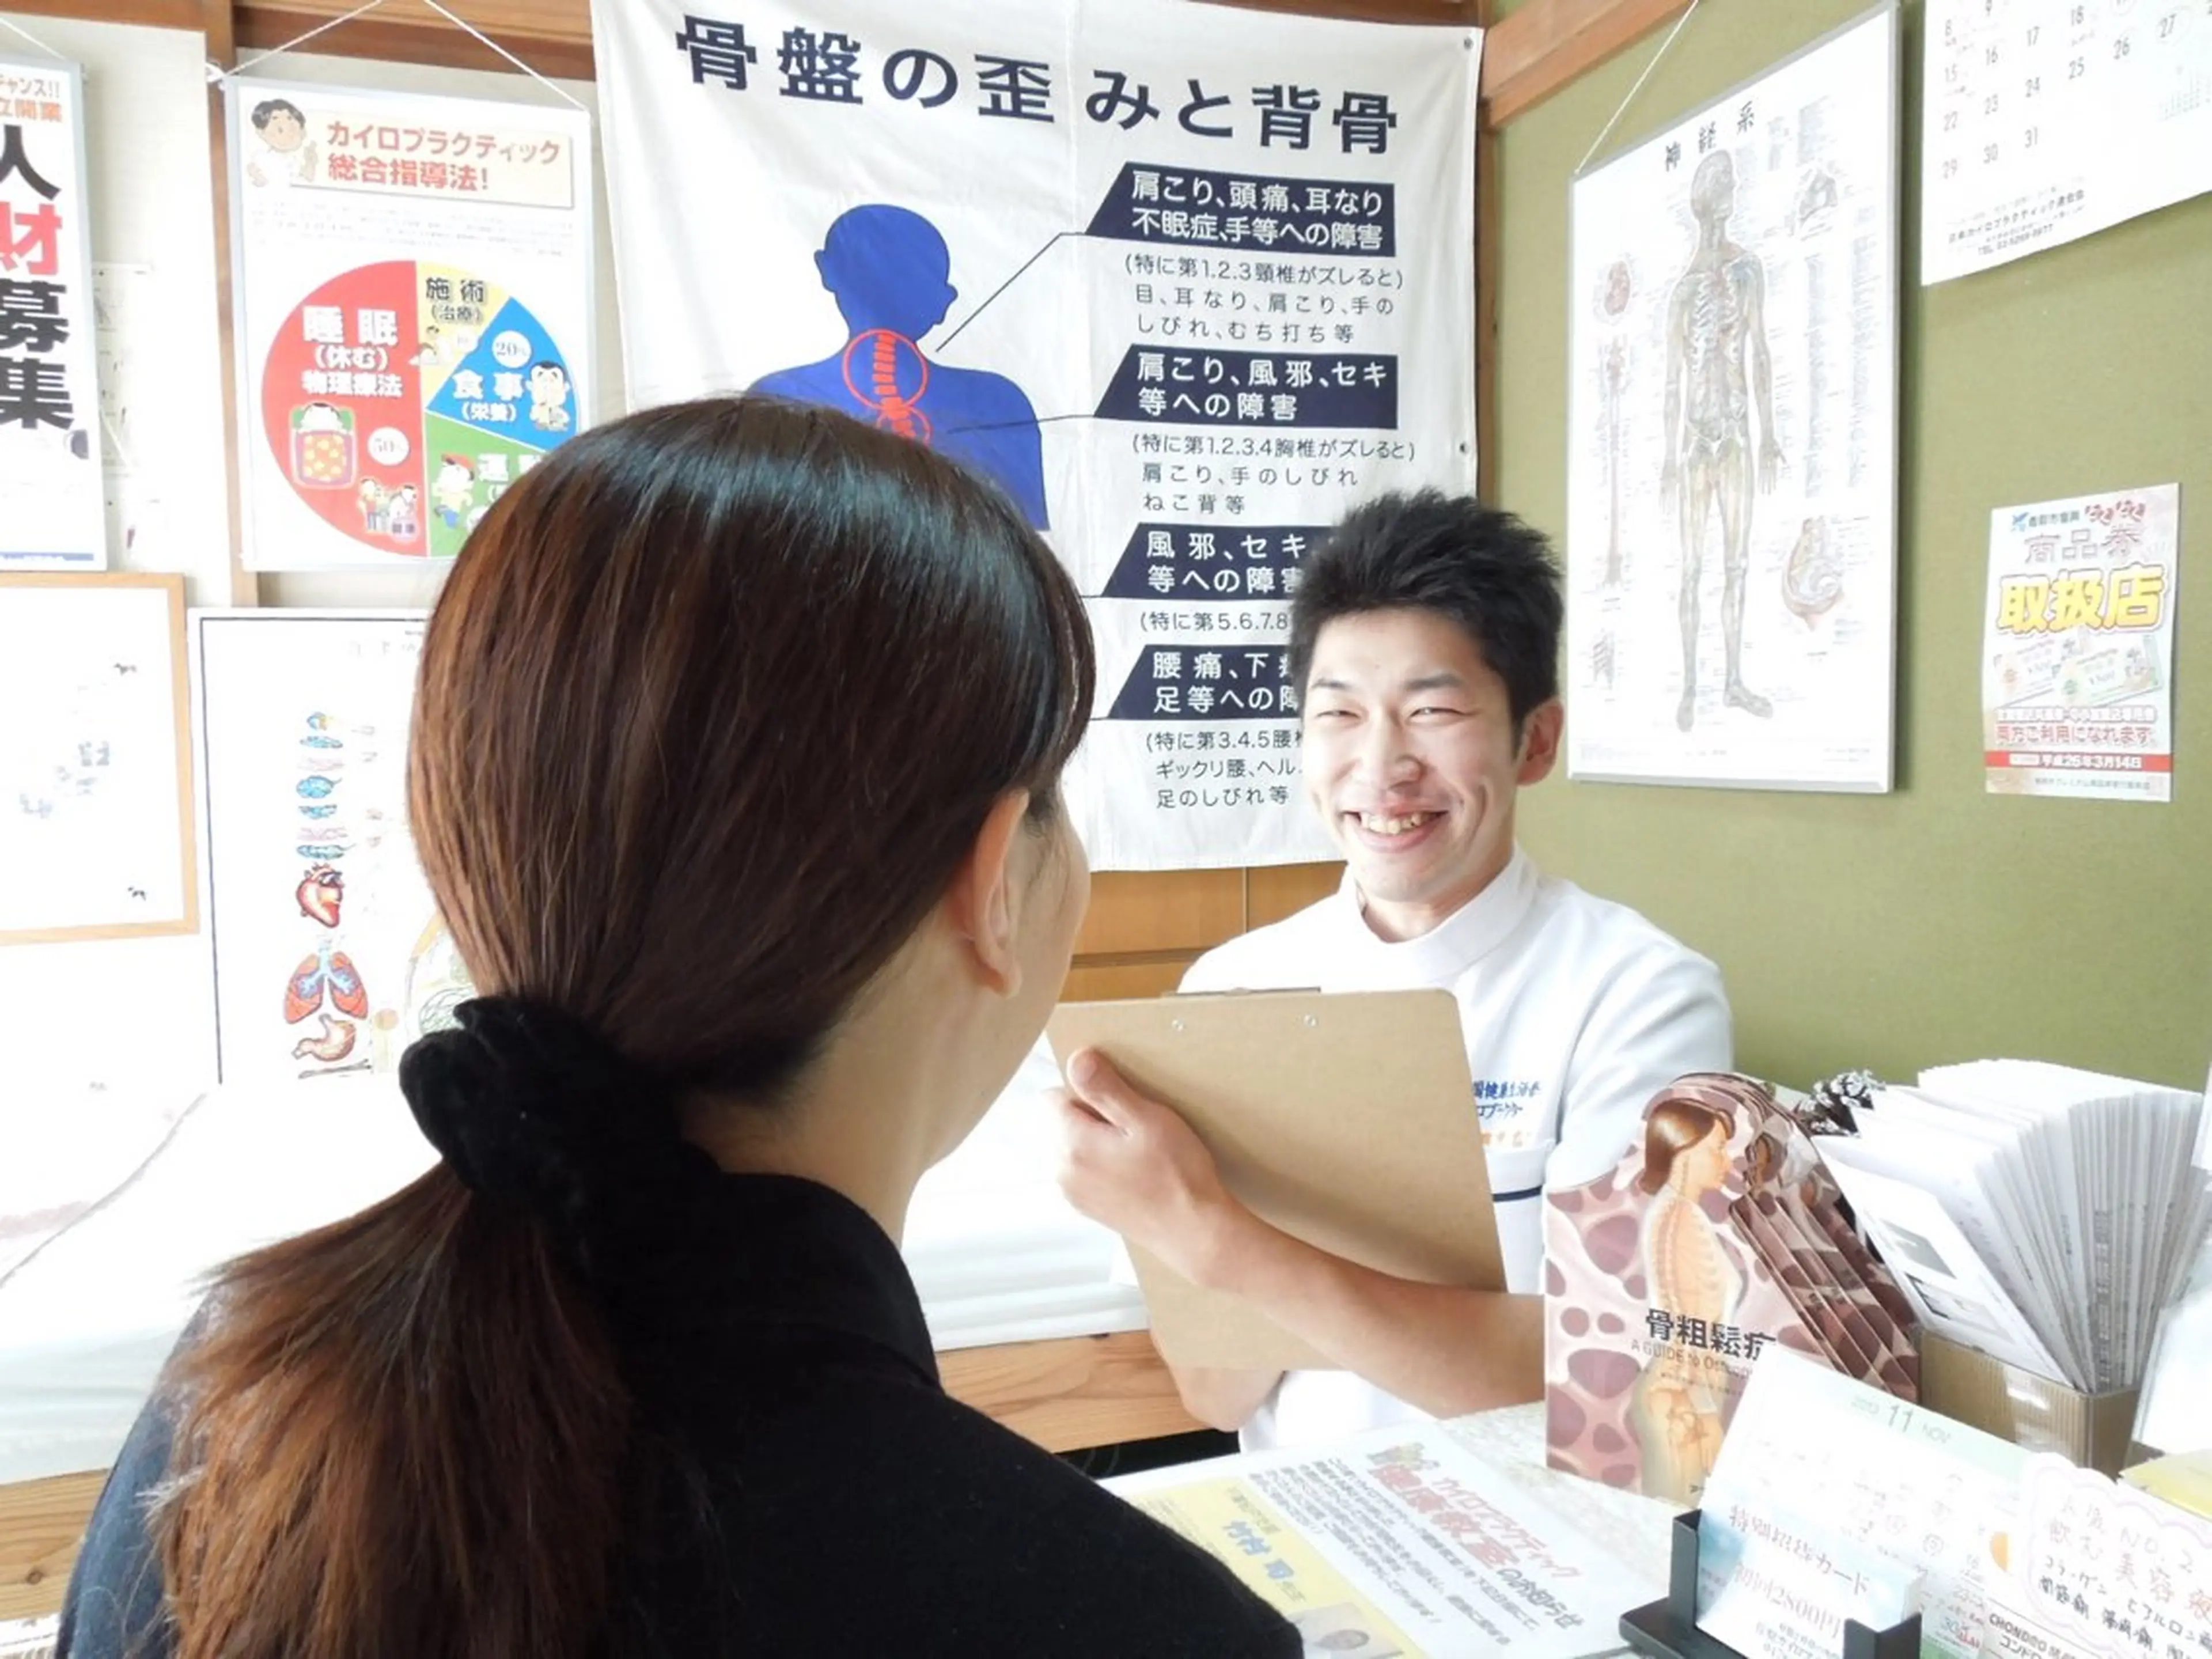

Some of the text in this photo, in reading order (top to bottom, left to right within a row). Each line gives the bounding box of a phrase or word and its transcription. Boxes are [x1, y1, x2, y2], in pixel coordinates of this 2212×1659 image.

[2026, 26, 2040, 47] 17
[2160, 13, 2177, 39] 27
[1986, 46, 1998, 66] 16
[2113, 37, 2130, 60] 26
[1944, 63, 1958, 82] 15
[2068, 55, 2085, 80] 25
[0, 74, 60, 99] ャンス!!
[676, 14, 1399, 154] 骨盤の歪みと背骨
[2025, 76, 2040, 98] 24
[1983, 93, 1998, 115] 23
[1943, 111, 1958, 132] 22
[327, 120, 561, 165] カイロプラクティック
[2024, 126, 2039, 149] 31
[1983, 142, 1999, 164] 30
[327, 153, 488, 191] 総合指導法!
[1942, 157, 1958, 180] 29
[1132, 170, 1382, 217] 肩こり、頭痛、耳なり
[1132, 207, 1383, 251] 不眠症、手等への障害
[425, 277, 485, 303] 施術
[1136, 283, 1394, 316] 目、耳なり、肩こり、手の
[304, 306, 398, 347] 睡眠
[1137, 313, 1355, 344] しびれ、むち打ち等
[315, 345, 389, 371] (休む)
[1137, 351, 1387, 389] 肩こり、風邪、セキ
[1138, 387, 1298, 421] 等への障害
[1142, 462, 1358, 487] 肩こり、手のしびれ
[1142, 494, 1246, 515] ねこ背等
[1146, 530, 1307, 560] 風邪、セキ
[2024, 524, 2145, 564] 商品券
[1147, 565, 1305, 594] 等への障害
[1996, 561, 2166, 635] 取扱店
[1156, 757, 1302, 780] ギックリ腰、ヘル
[1156, 785, 1289, 809] 足のしびれ等
[1631, 1339, 1641, 1353] A
[1642, 1341, 1685, 1363] GUIDE
[1888, 1404, 1914, 1433] 11
[1922, 1422, 1952, 1444] NOV
